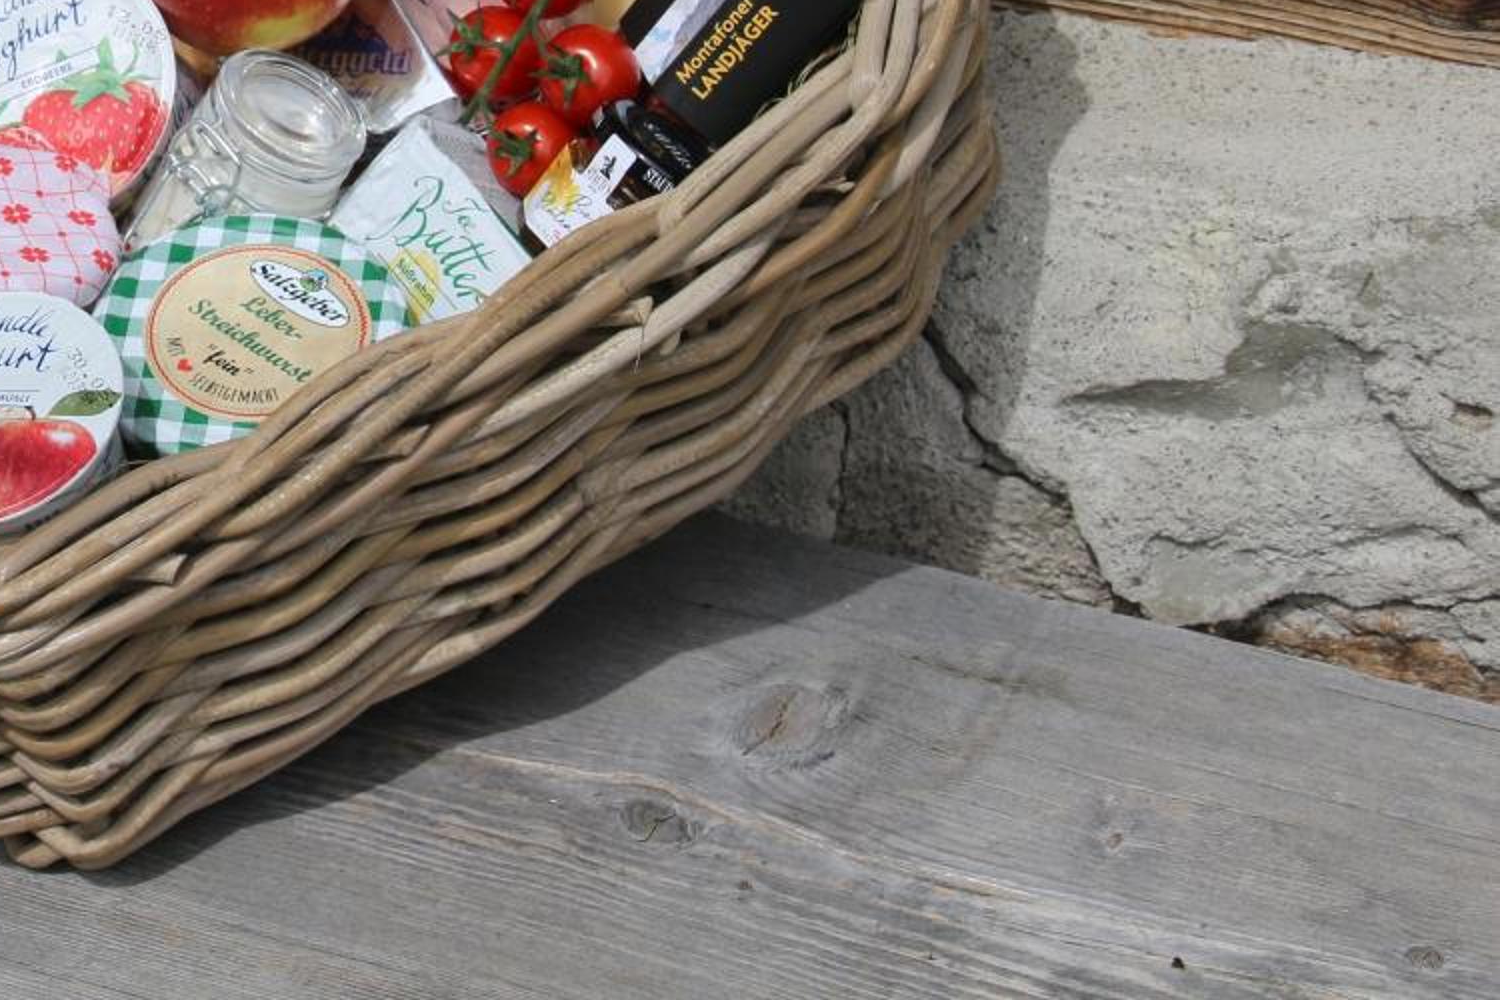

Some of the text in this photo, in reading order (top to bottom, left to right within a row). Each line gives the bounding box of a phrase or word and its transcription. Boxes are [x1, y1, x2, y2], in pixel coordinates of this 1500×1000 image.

[690, 3, 780, 101] LANDJÄGER
[239, 297, 303, 340] Leber-
[251, 263, 350, 322] Salzgeber
[188, 299, 312, 383] Streichwurst
